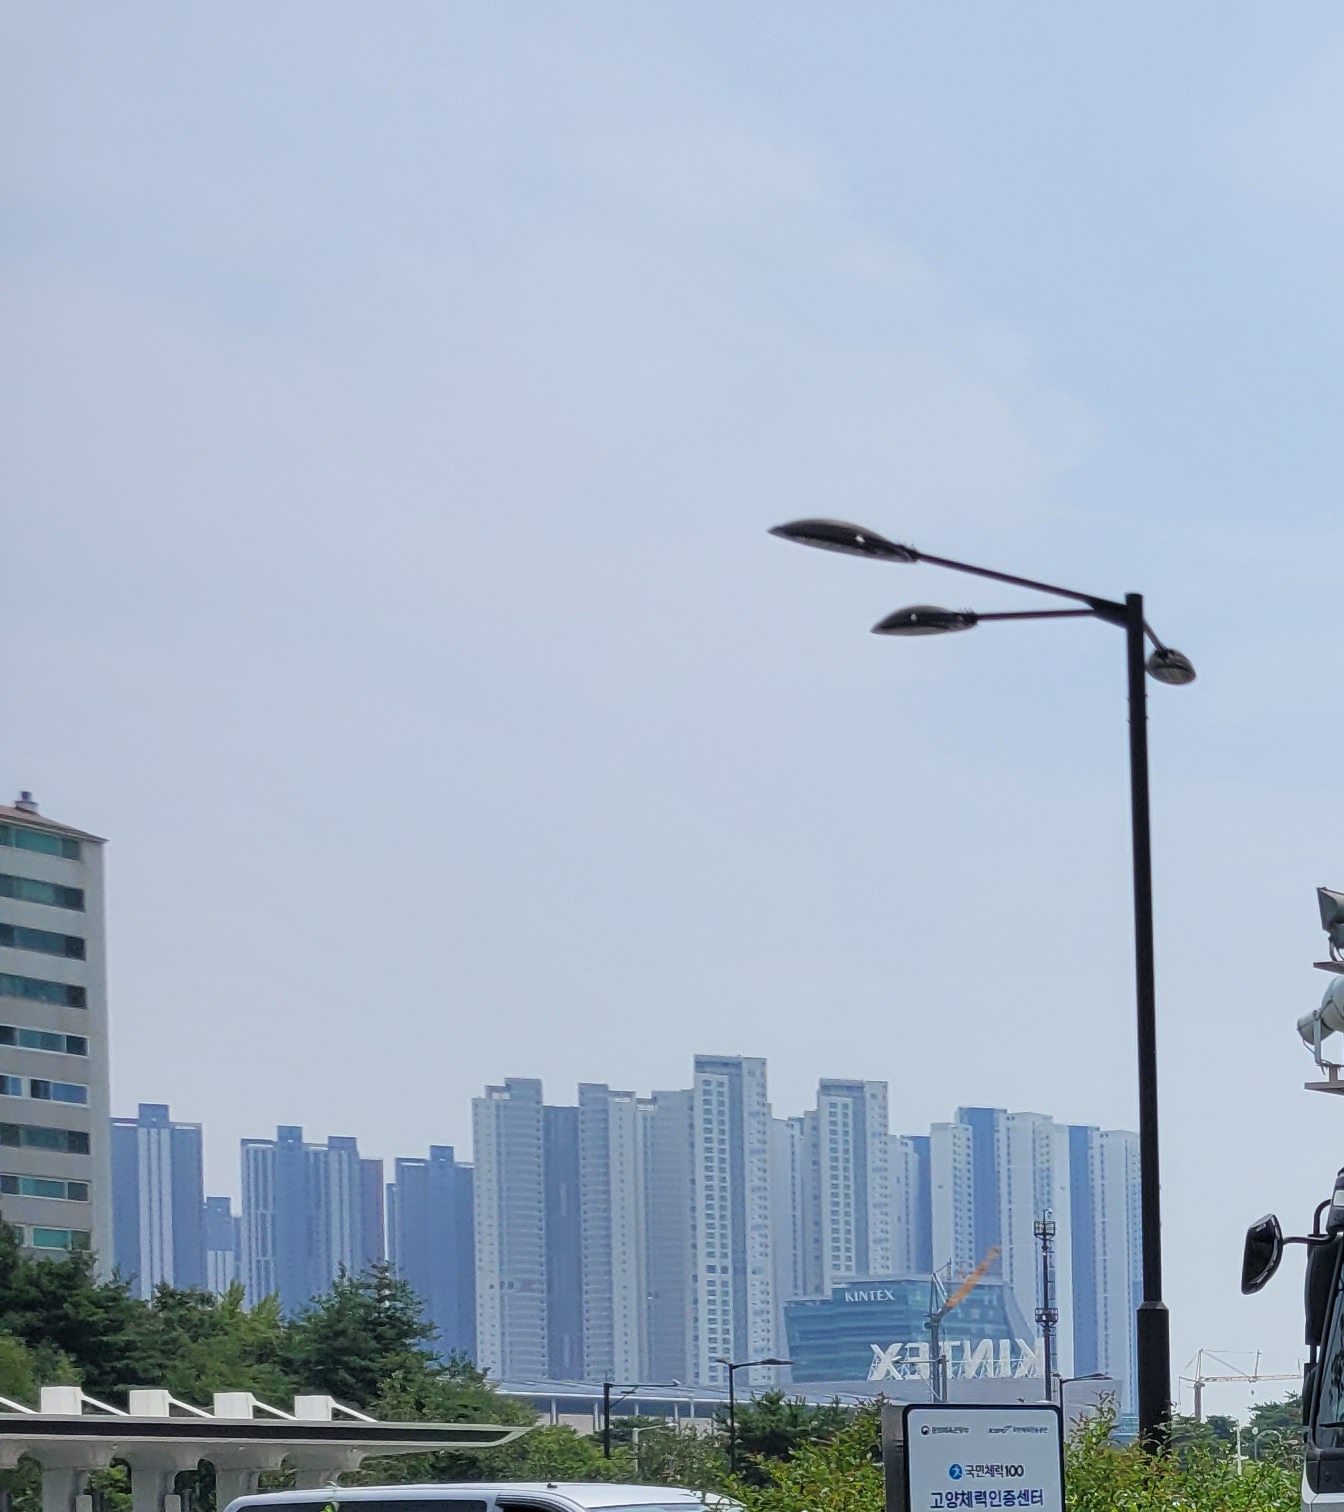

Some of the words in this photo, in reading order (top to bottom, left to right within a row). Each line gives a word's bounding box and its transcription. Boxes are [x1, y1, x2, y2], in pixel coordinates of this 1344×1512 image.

[845, 1289, 895, 1302] KINTEX
[964, 1464, 1024, 1479] 국민체력100
[929, 1488, 1044, 1510] 고양체력인증센터
